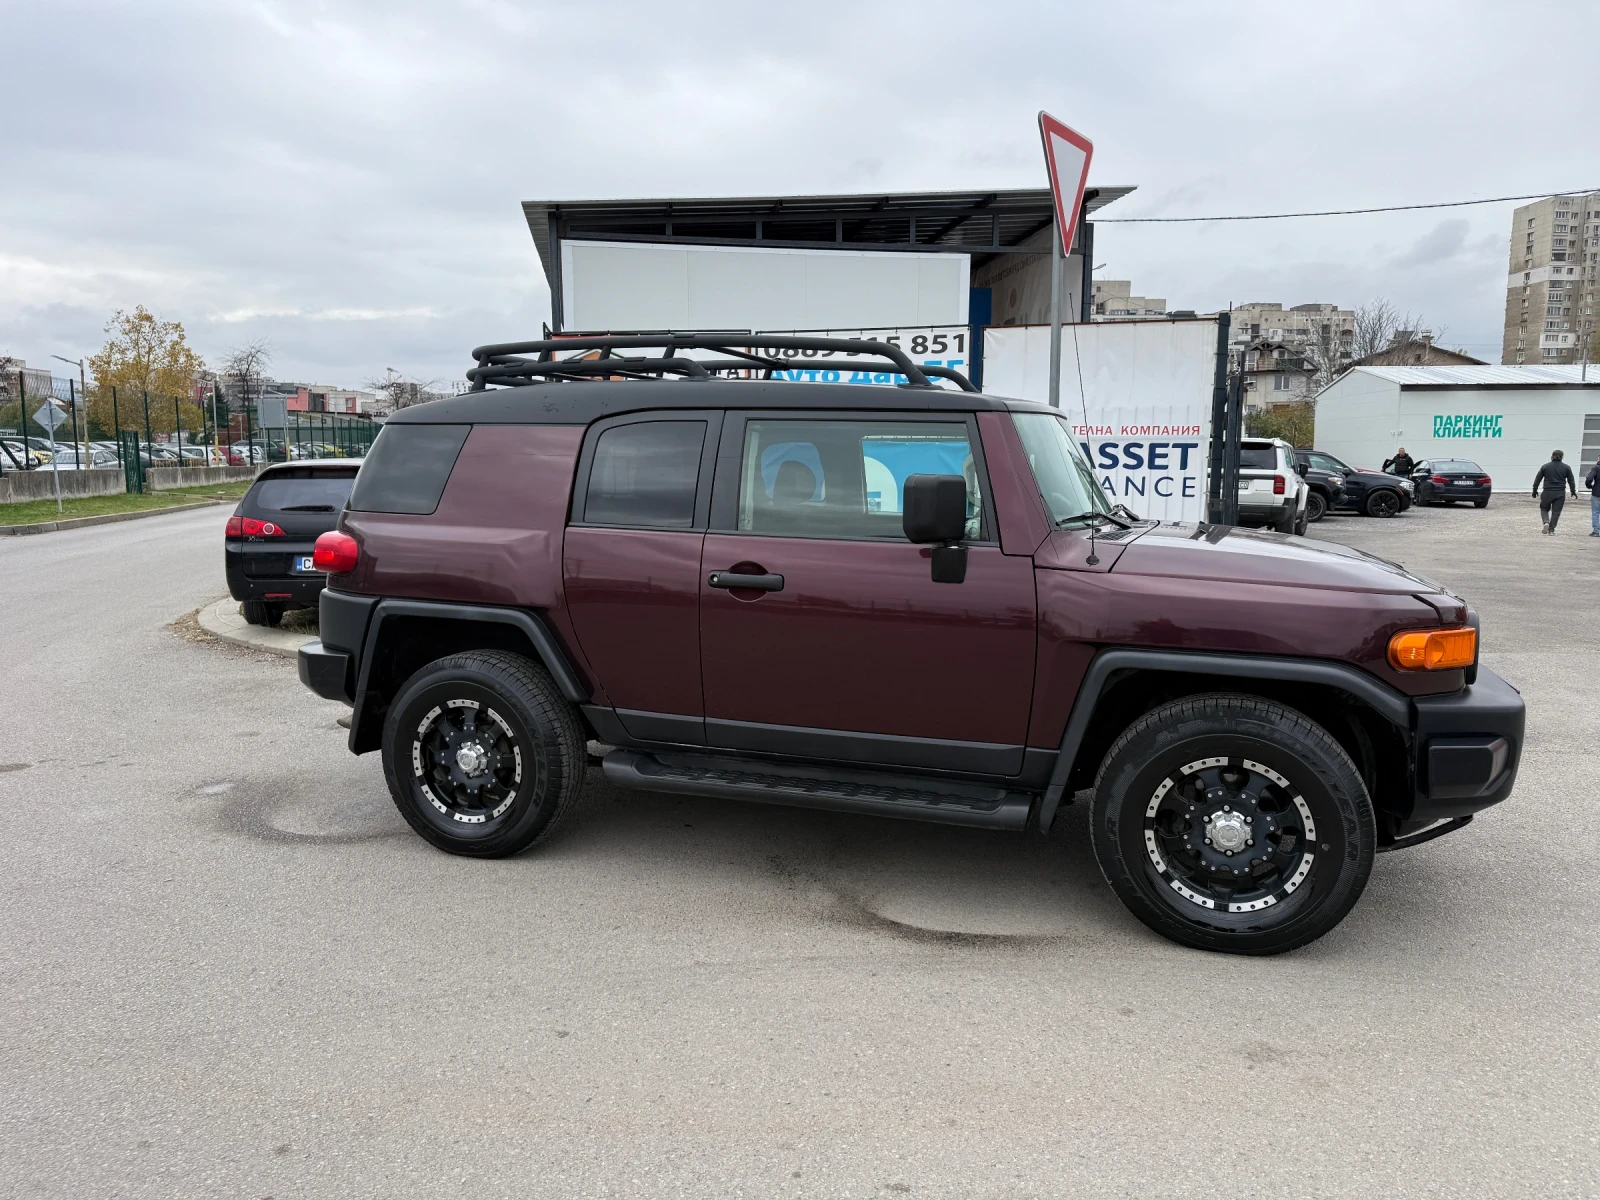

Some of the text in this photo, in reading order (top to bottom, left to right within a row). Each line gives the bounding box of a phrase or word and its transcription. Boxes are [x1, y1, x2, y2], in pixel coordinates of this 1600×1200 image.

[911, 334, 965, 354] 851
[1433, 414, 1503, 427] ПАРКИНГ
[1121, 425, 1200, 435] КОМПАНИЯ
[1433, 426, 1503, 438] КЛИЕНТИ
[1101, 475, 1197, 498] ANCE
[303, 558, 315, 570] C
